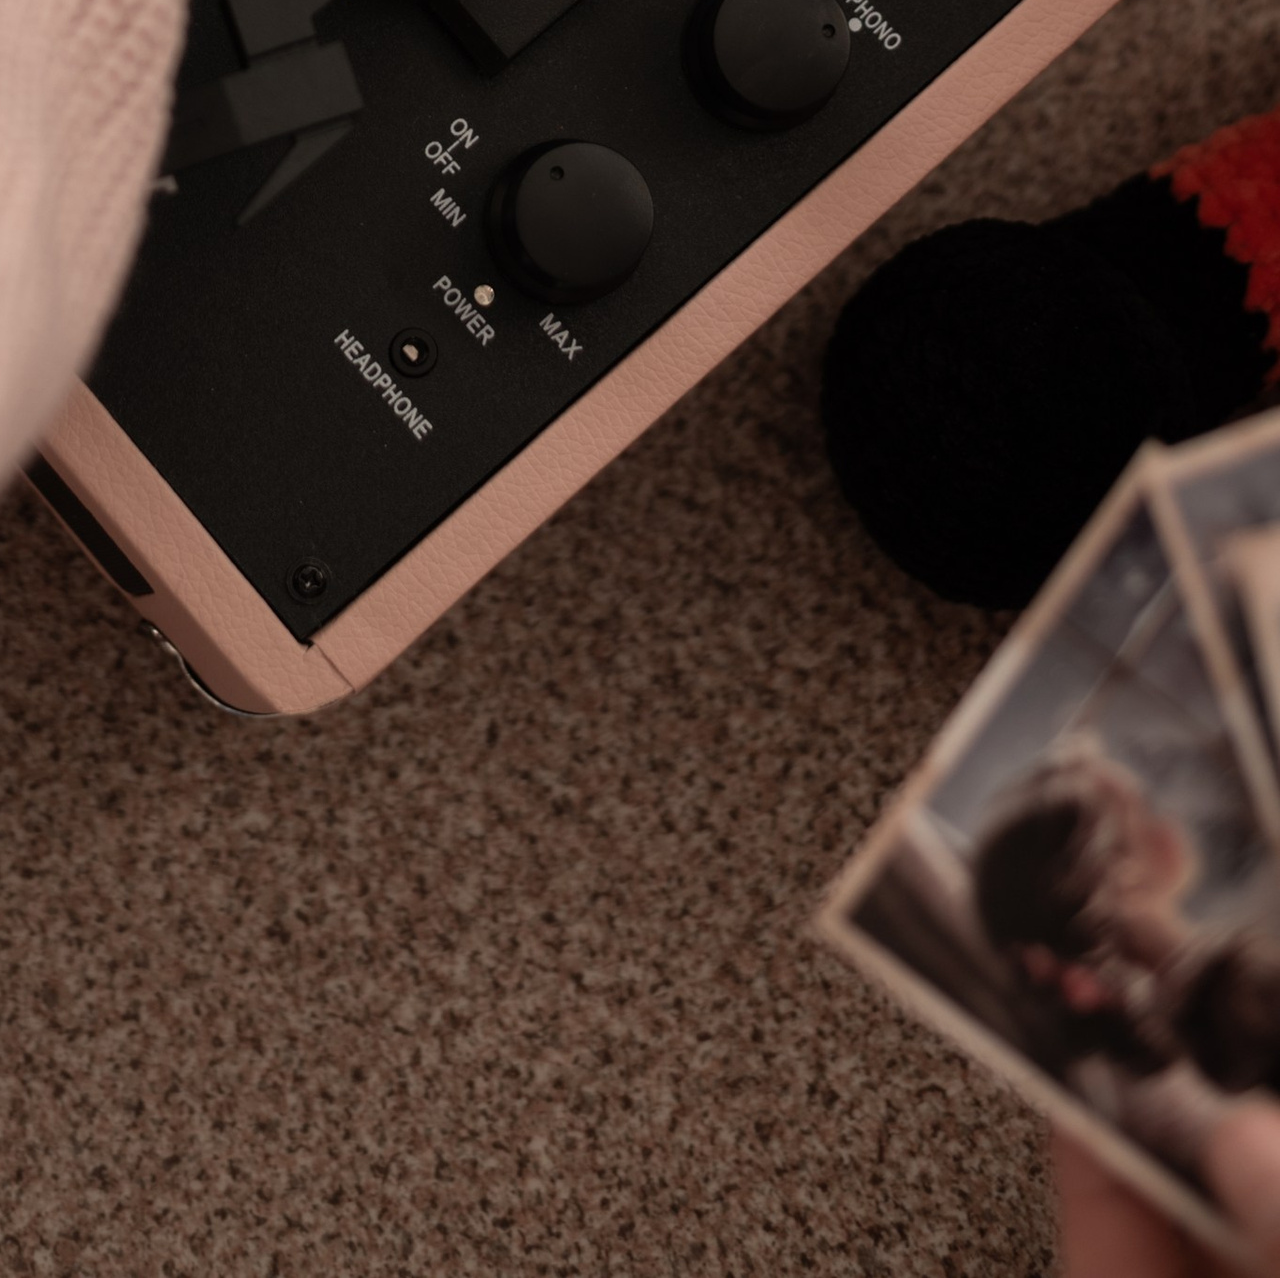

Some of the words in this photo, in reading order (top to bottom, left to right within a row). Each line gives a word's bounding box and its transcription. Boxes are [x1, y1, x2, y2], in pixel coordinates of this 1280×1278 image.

[450, 118, 479, 148] ON
[425, 141, 460, 174] OFF
[430, 188, 466, 226] MIN
[432, 275, 494, 346] POWER
[539, 313, 582, 360] MAX
[334, 329, 432, 439] HEADPHONE
